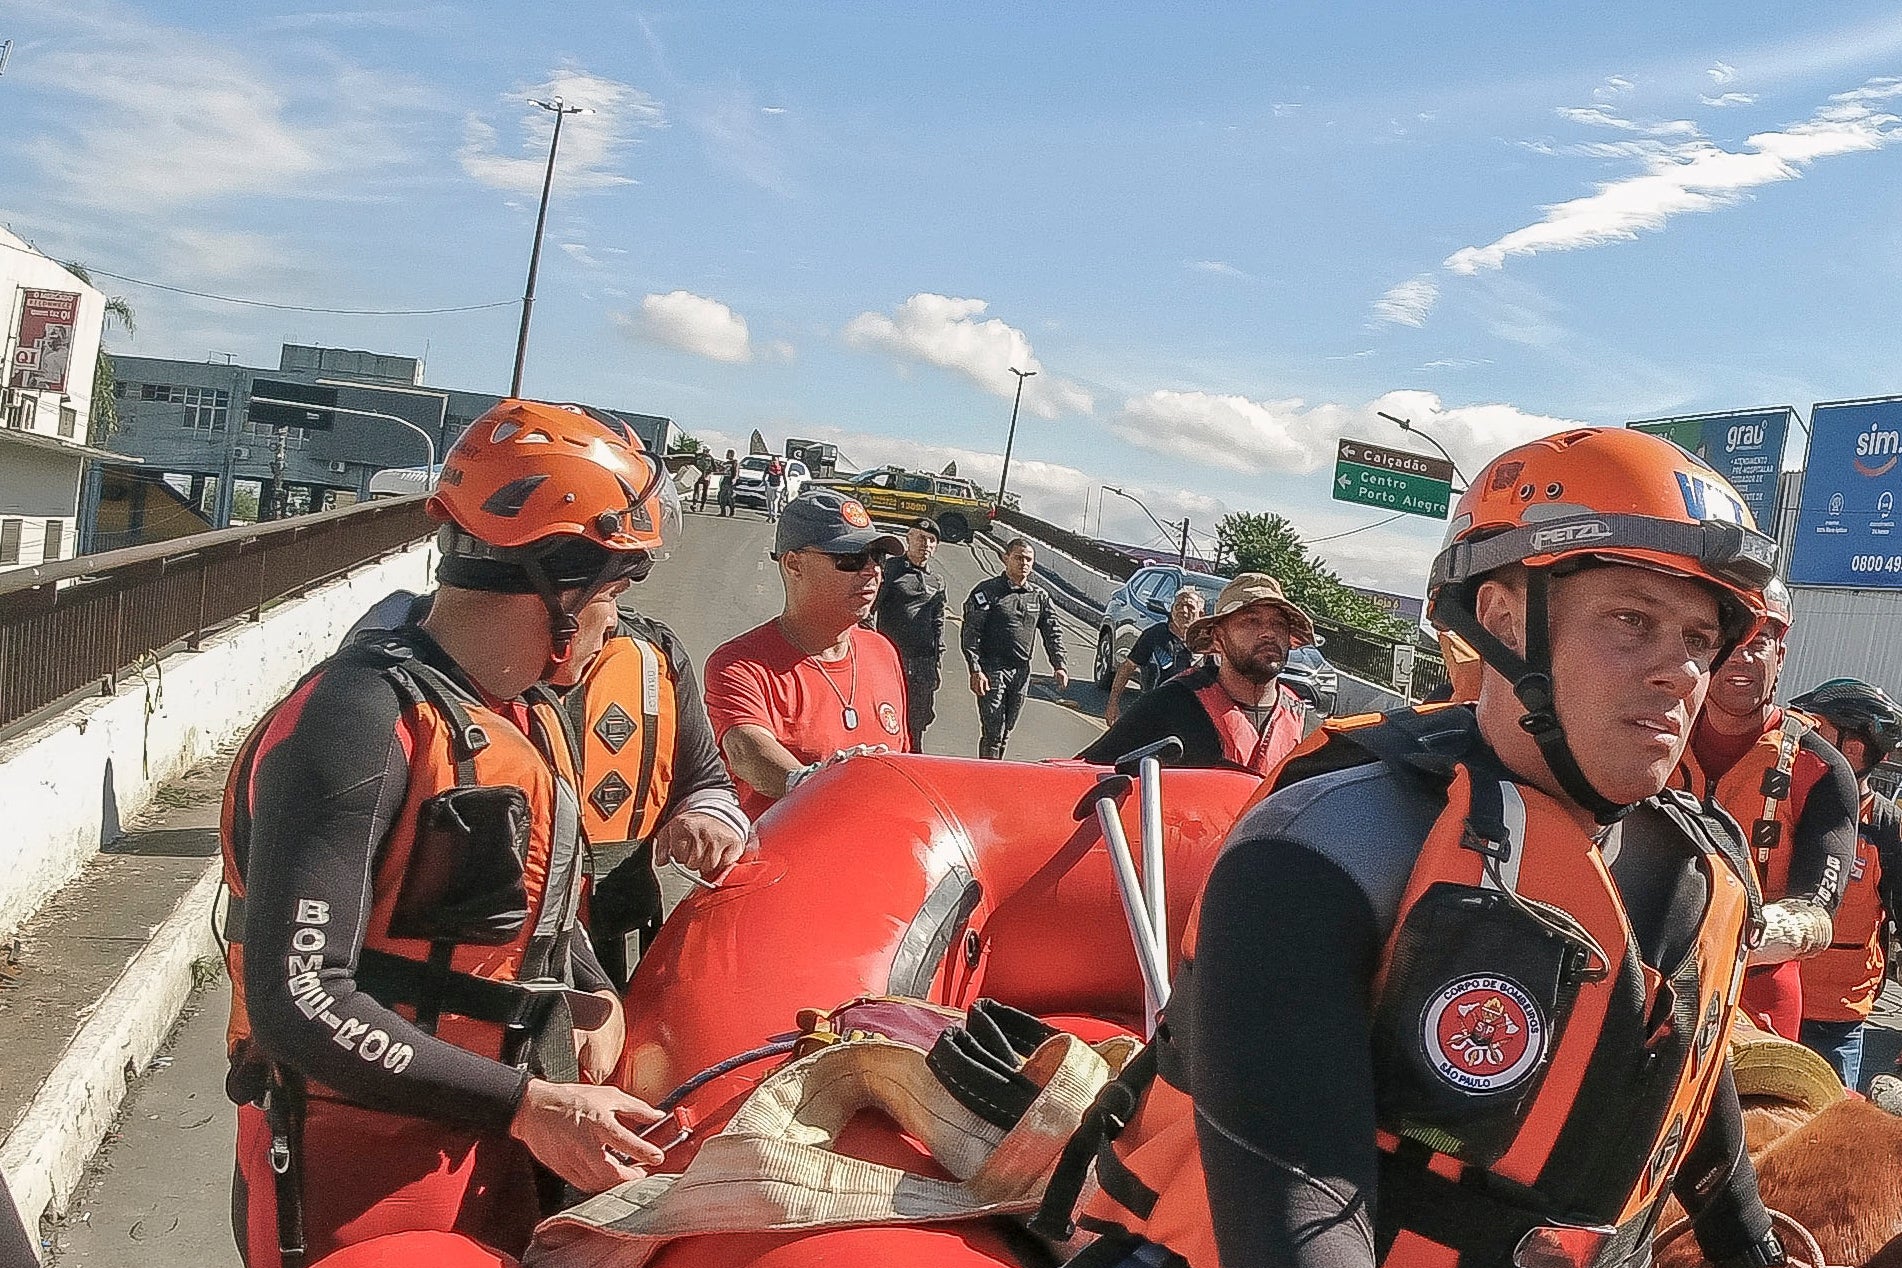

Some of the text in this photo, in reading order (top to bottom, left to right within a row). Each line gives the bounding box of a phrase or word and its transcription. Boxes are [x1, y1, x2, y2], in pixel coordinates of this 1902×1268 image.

[16, 350, 37, 365] QI
[1363, 449, 1428, 472] Calçadão
[1360, 471, 1407, 490] Centro
[1358, 486, 1446, 513] Porto Alegre
[1541, 523, 1601, 542] PETZL
[1851, 555, 1883, 573] 0800
[287, 898, 415, 1075] BOMBEIROS
[1443, 979, 1540, 1034] CORPO DE BOMBEIROS
[1475, 1021, 1495, 1035] SP
[1439, 1061, 1491, 1088] SÃO PAULO
